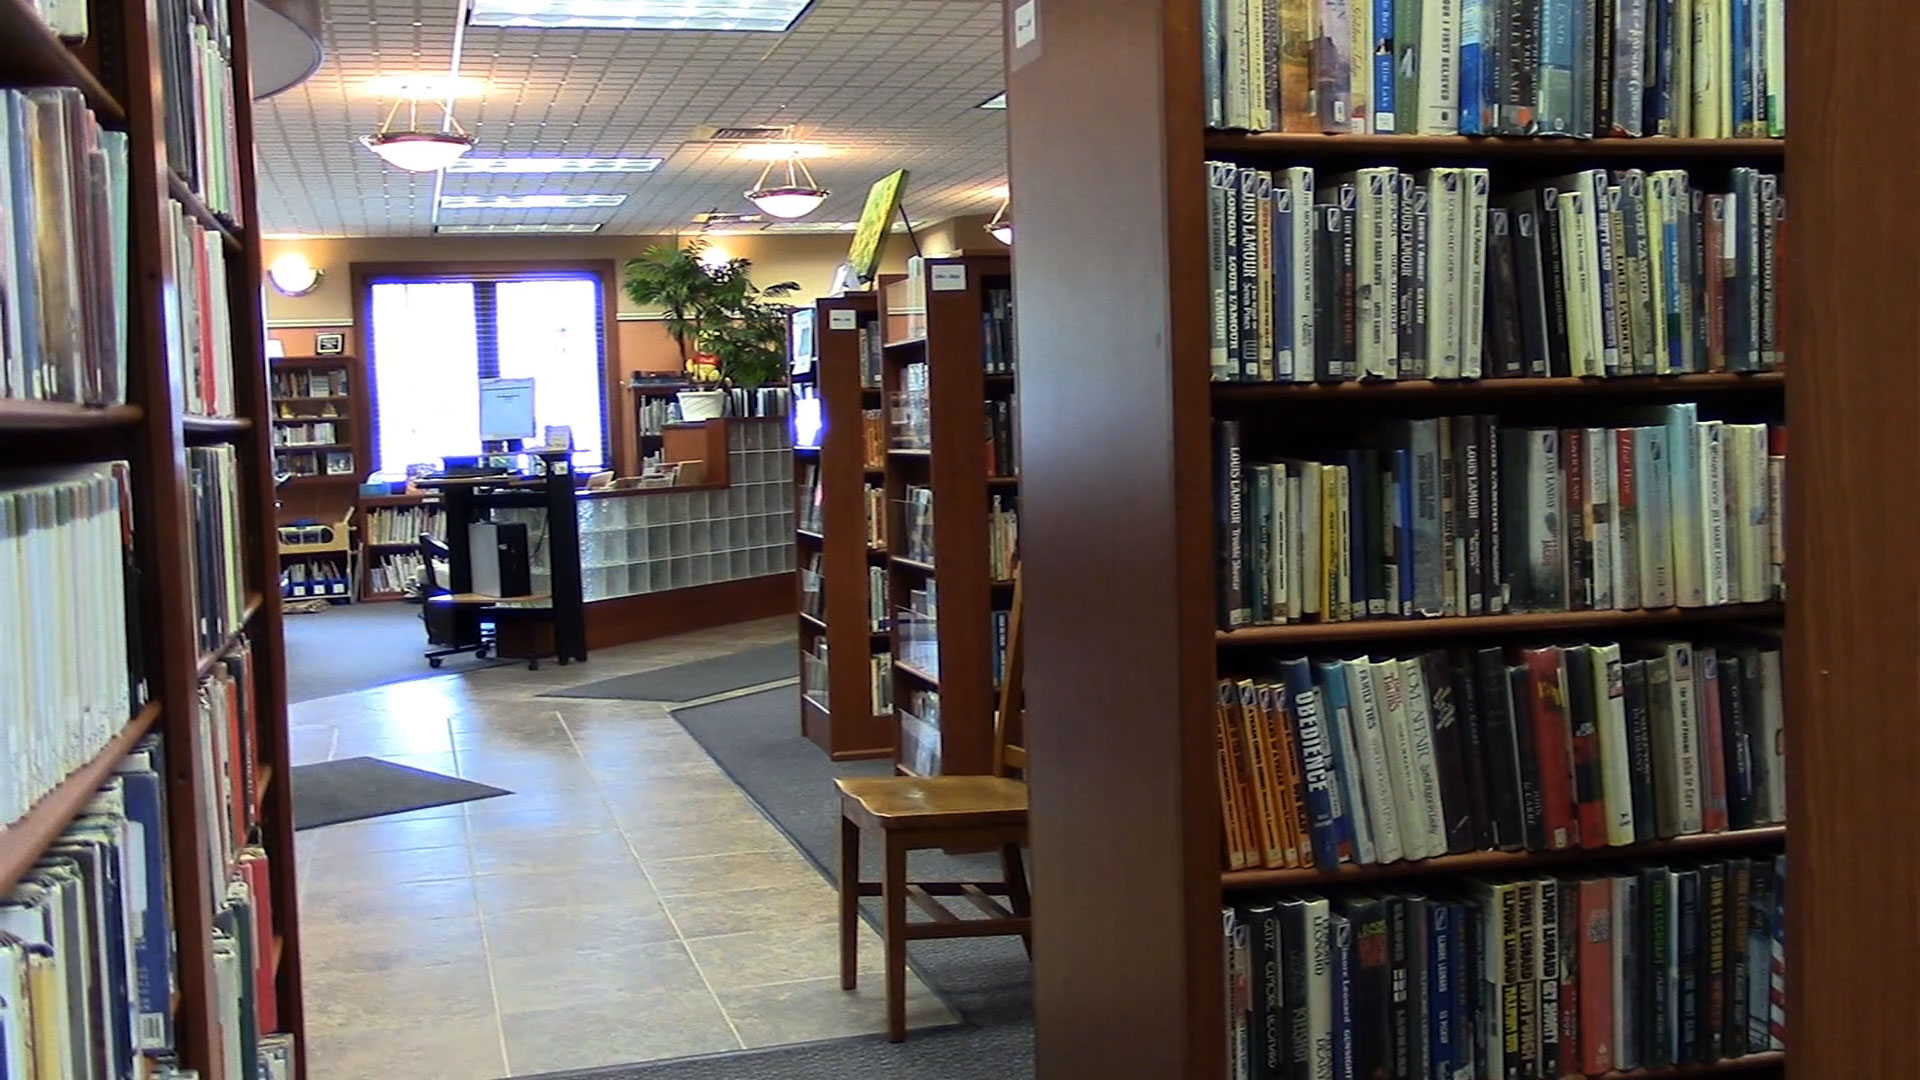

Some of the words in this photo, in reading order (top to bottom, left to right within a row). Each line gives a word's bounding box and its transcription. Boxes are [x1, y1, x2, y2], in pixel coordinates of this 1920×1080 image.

[1441, 28, 1451, 54] FIRST
[1440, 57, 1451, 101] BELIEVED
[1227, 256, 1238, 291] LOUIS
[1228, 295, 1239, 350] L'AMOUR
[1229, 447, 1240, 478] LOUIS
[1467, 446, 1479, 475] LOUIS
[1230, 480, 1241, 524] L'AMOUR
[1468, 477, 1480, 519] L'AMOUR
[1359, 668, 1374, 704] FAMILY
[1364, 706, 1377, 730] TIES
[1294, 691, 1328, 793] OBEDIENCE
[1519, 886, 1533, 929] ELMORE
[1543, 884, 1556, 926] ELMORE
[1711, 876, 1724, 907] JOHN
[1503, 890, 1516, 937] ELMORE
[1313, 916, 1324, 977] LEONARD
[1341, 947, 1350, 977] lmore
[1504, 938, 1517, 984] LEONARD
[1520, 930, 1533, 980] LEONARD
[1543, 927, 1556, 978] LEONARD
[1711, 909, 1724, 974] LESCROART
[1341, 980, 1351, 1023] Leonard
[1543, 980, 1557, 1000] GET
[1292, 1008, 1309, 1064] KILLSHOT
[1544, 1002, 1557, 1044] SHORTY
